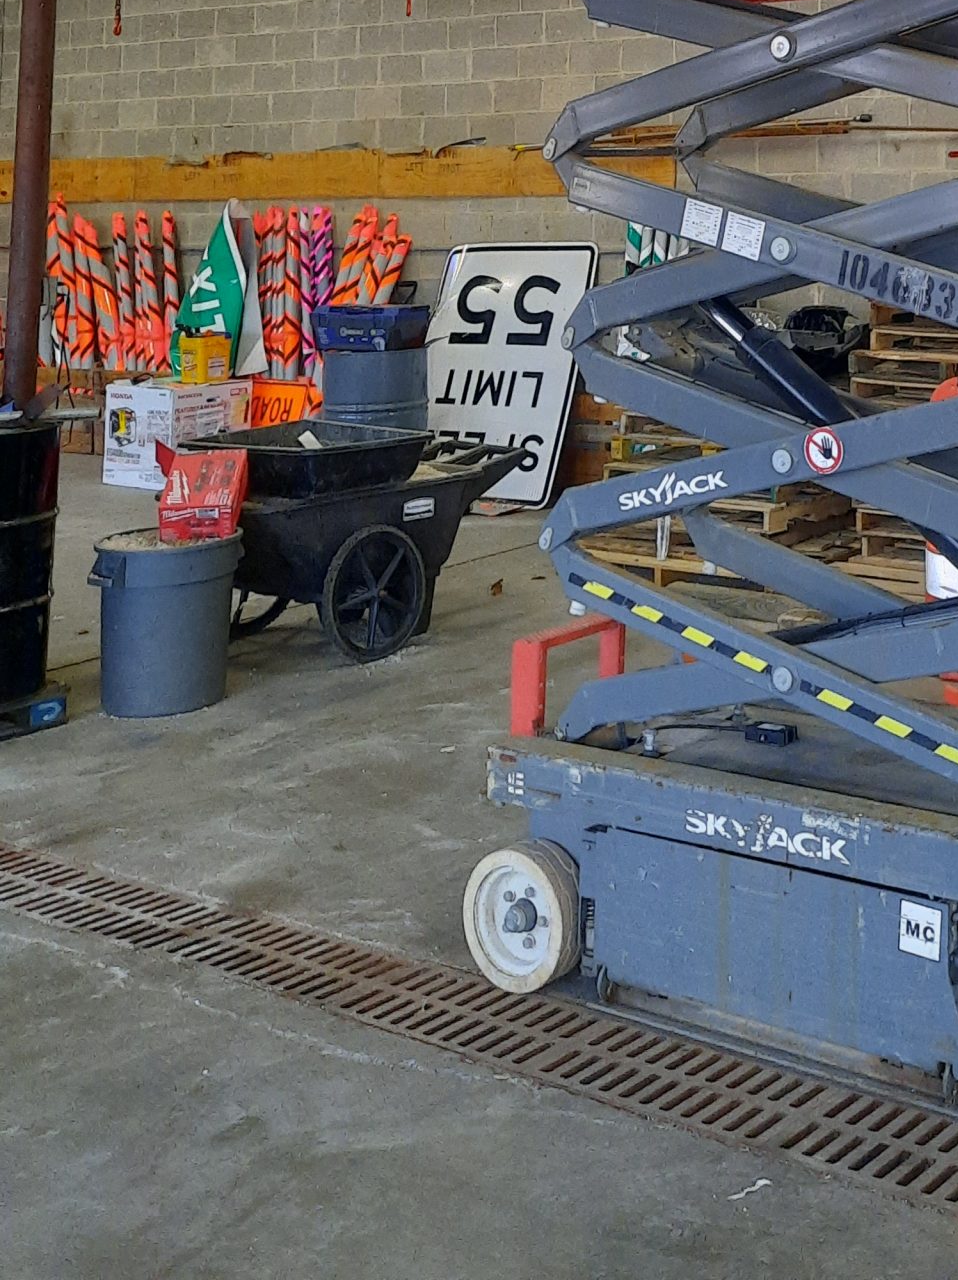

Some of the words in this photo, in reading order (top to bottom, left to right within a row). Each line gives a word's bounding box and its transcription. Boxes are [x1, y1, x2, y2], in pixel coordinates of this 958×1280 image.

[189, 245, 226, 332] XIT
[448, 274, 561, 346] 55
[435, 368, 544, 408] LIMIT
[618, 470, 728, 511] SKYJACK
[685, 809, 852, 866] SKYJACK
